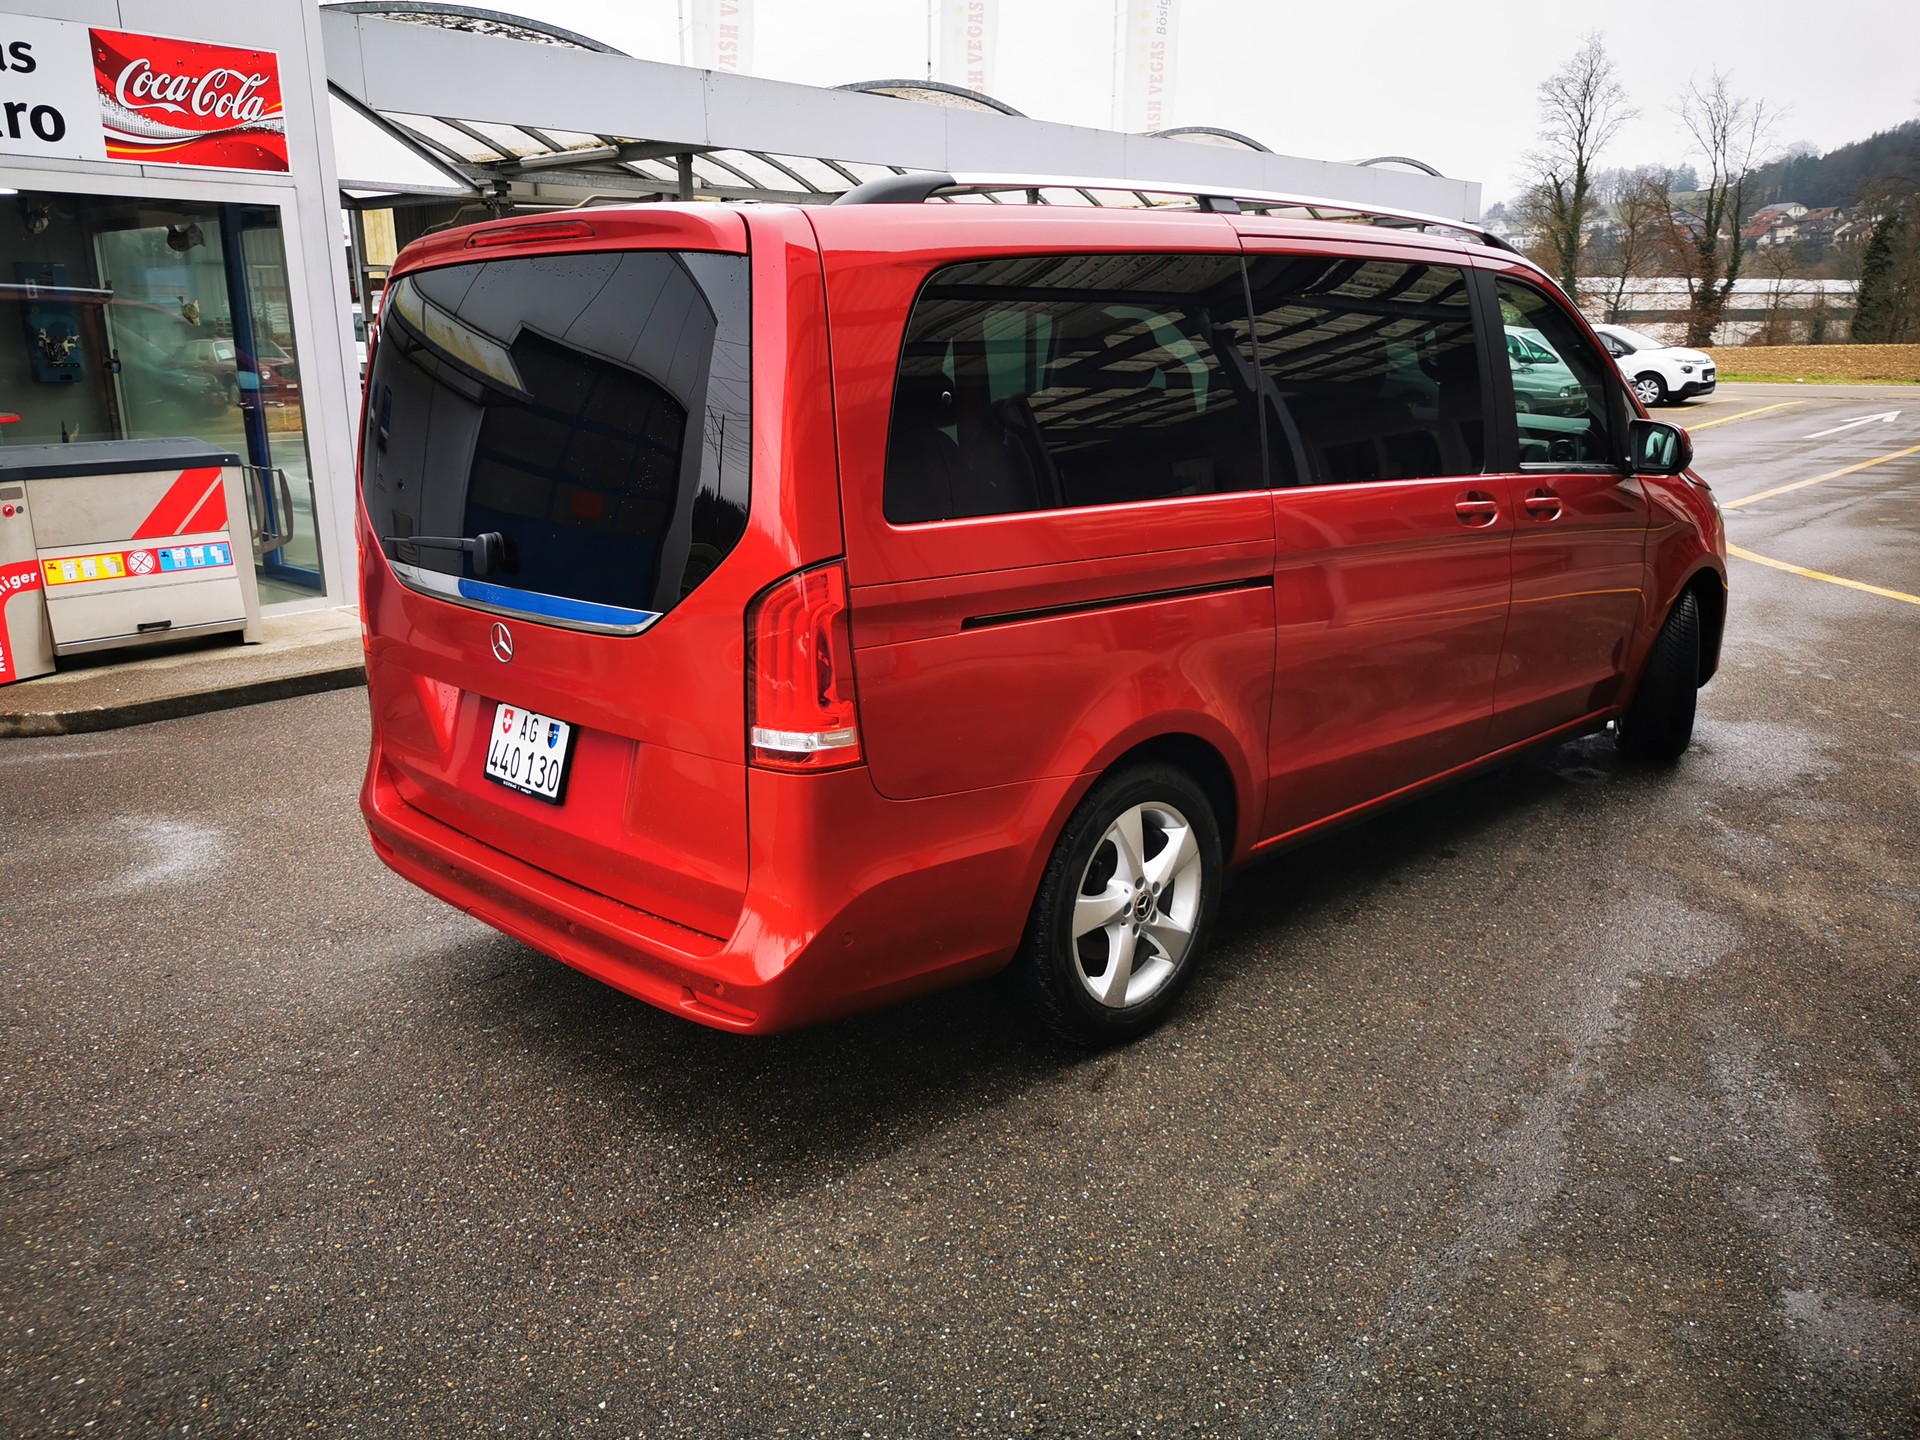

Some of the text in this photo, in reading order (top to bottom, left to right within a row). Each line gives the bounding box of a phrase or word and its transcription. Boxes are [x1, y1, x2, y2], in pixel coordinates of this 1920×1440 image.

[967, 1, 984, 65] VEGAS
[115, 58, 271, 122] Coca-Cola
[1149, 41, 1165, 96] VEGAS
[519, 715, 539, 743] AG
[489, 740, 559, 792] 440 130
